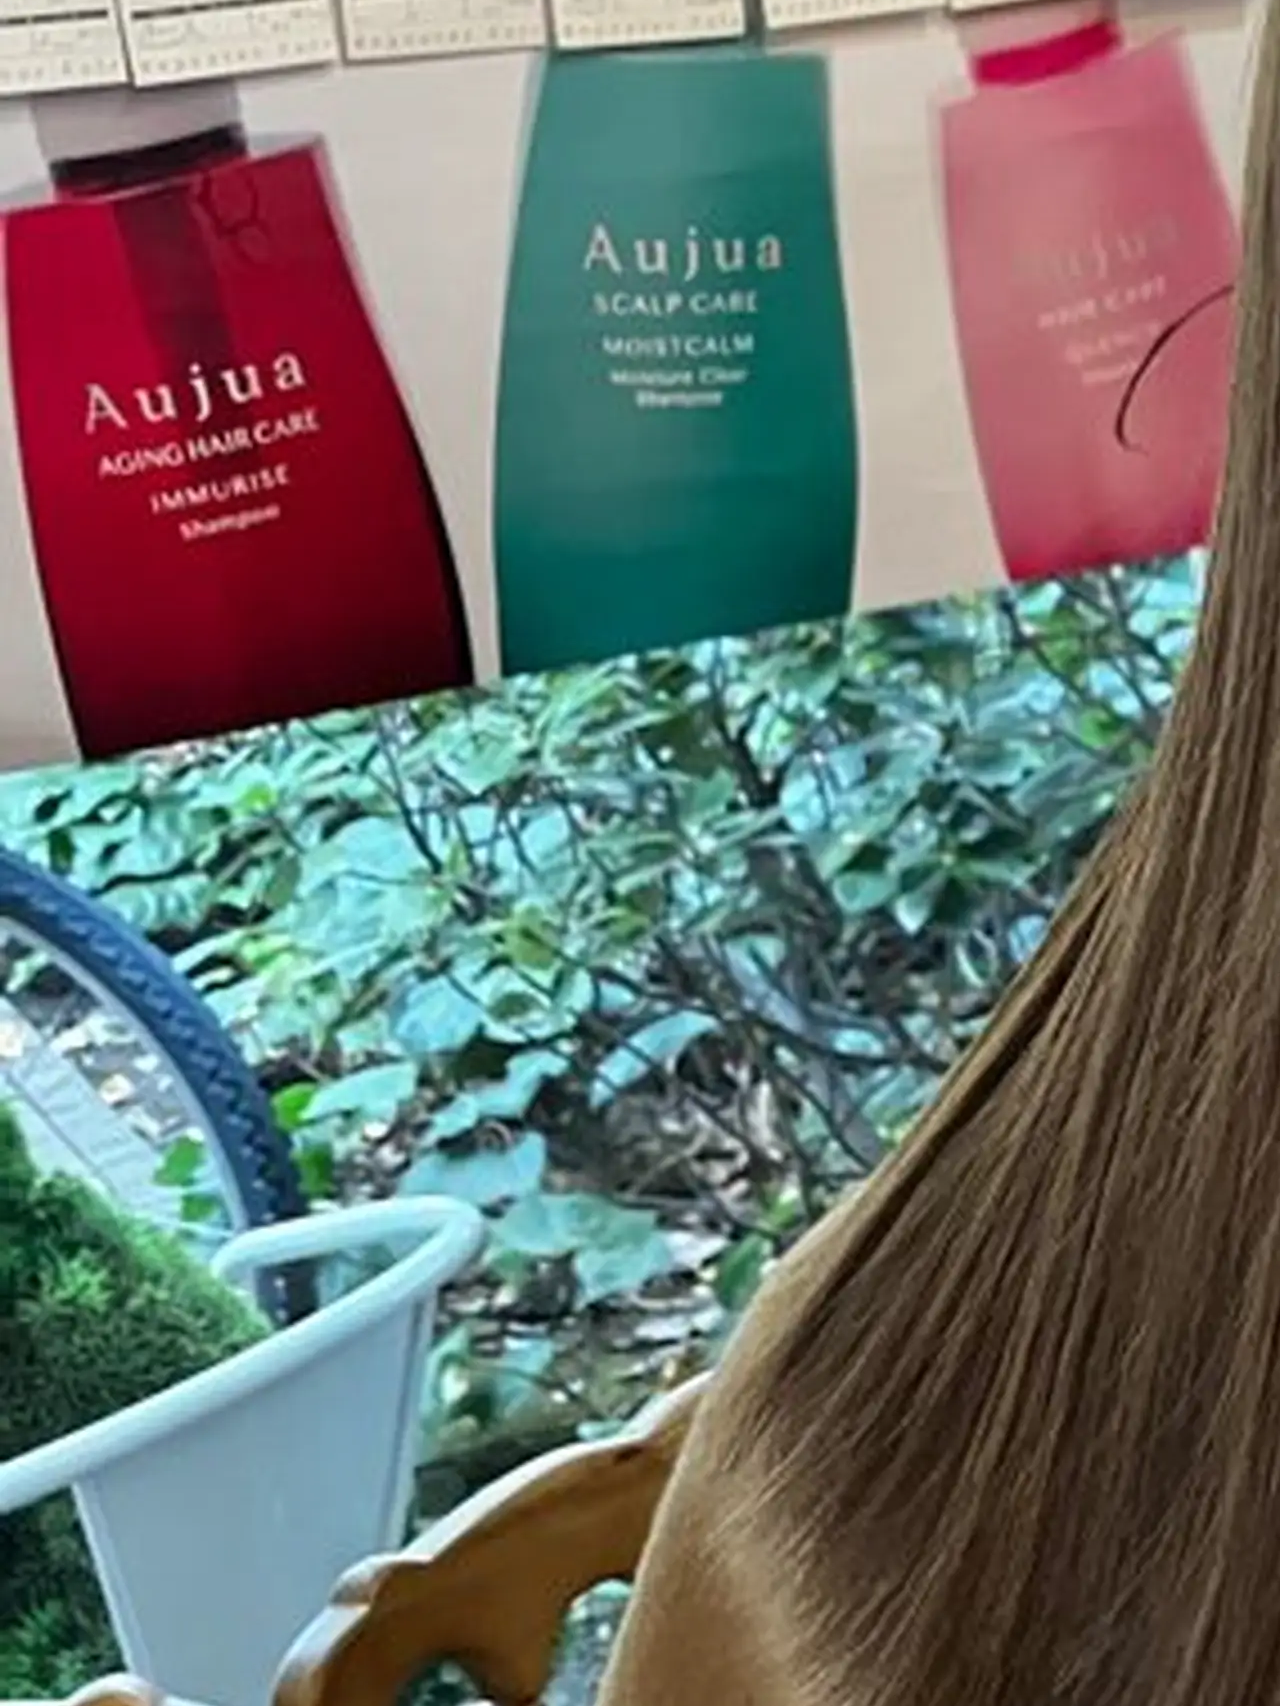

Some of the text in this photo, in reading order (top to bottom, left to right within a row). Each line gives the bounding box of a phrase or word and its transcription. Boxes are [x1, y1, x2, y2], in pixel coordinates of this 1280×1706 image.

[583, 222, 783, 282] Aujua
[593, 289, 758, 317] SCALP CARE
[84, 350, 307, 435] Aujua
[98, 405, 321, 478] AGING HAIR CARE
[150, 462, 290, 516] IMMURISE
